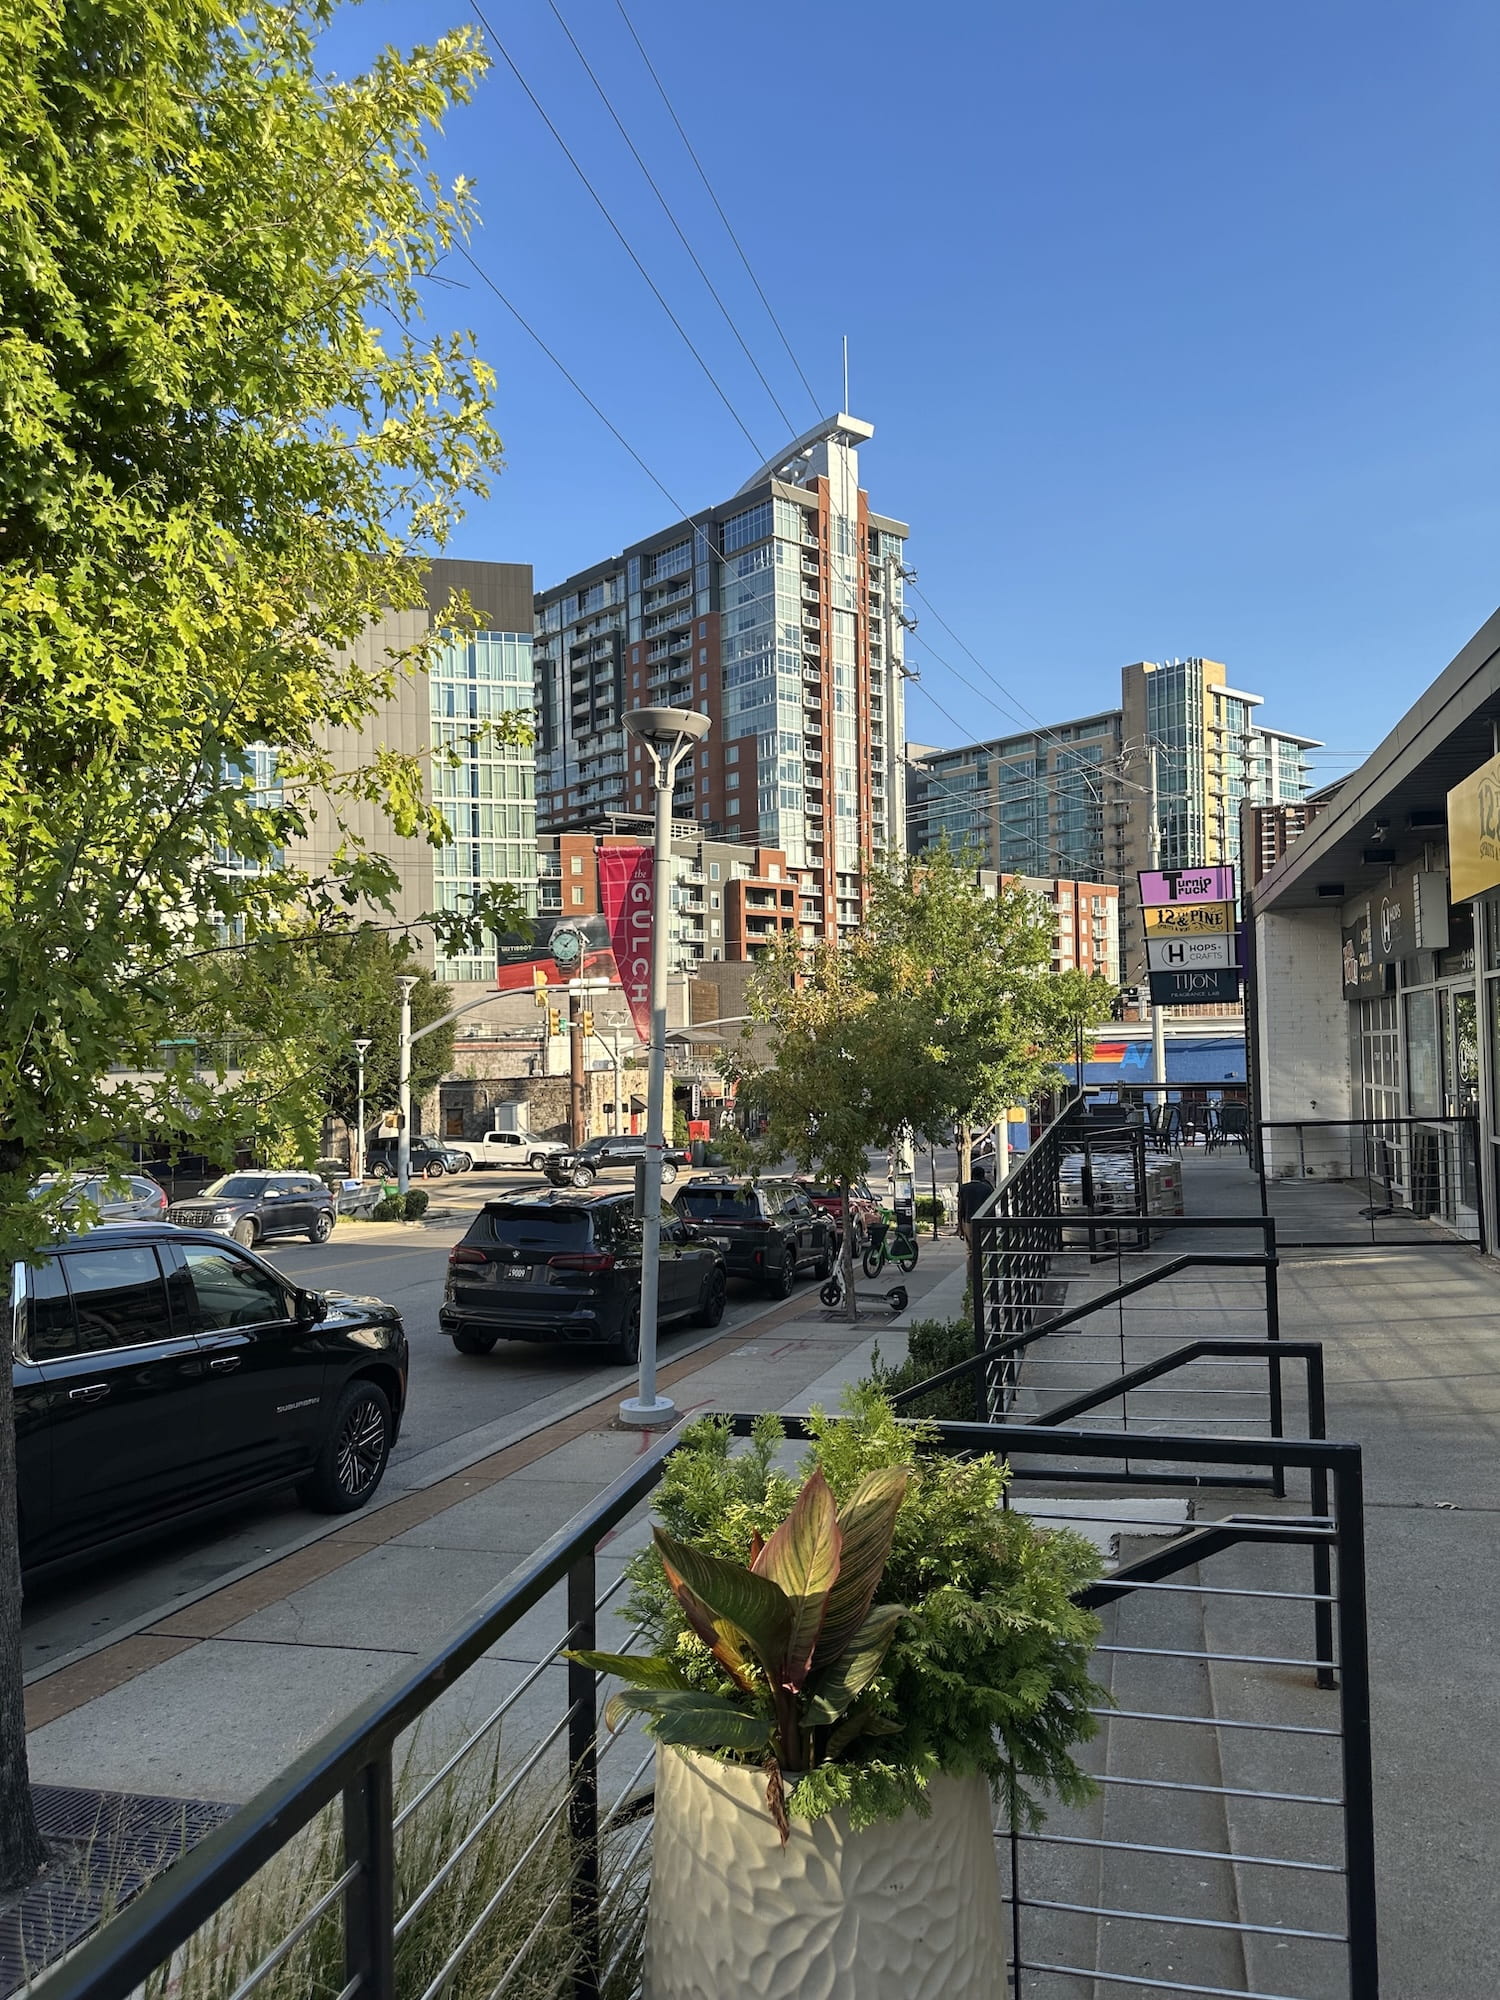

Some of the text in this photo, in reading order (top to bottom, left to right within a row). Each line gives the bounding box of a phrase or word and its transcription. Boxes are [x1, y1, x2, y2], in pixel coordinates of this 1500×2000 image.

[634, 870, 647, 879] the
[1190, 910, 1223, 925] PINE
[631, 882, 651, 1003] GULCH
[1190, 943, 1217, 951] HOPS
[1190, 952, 1222, 960] CRAFTS
[1461, 949, 1475, 970] 319
